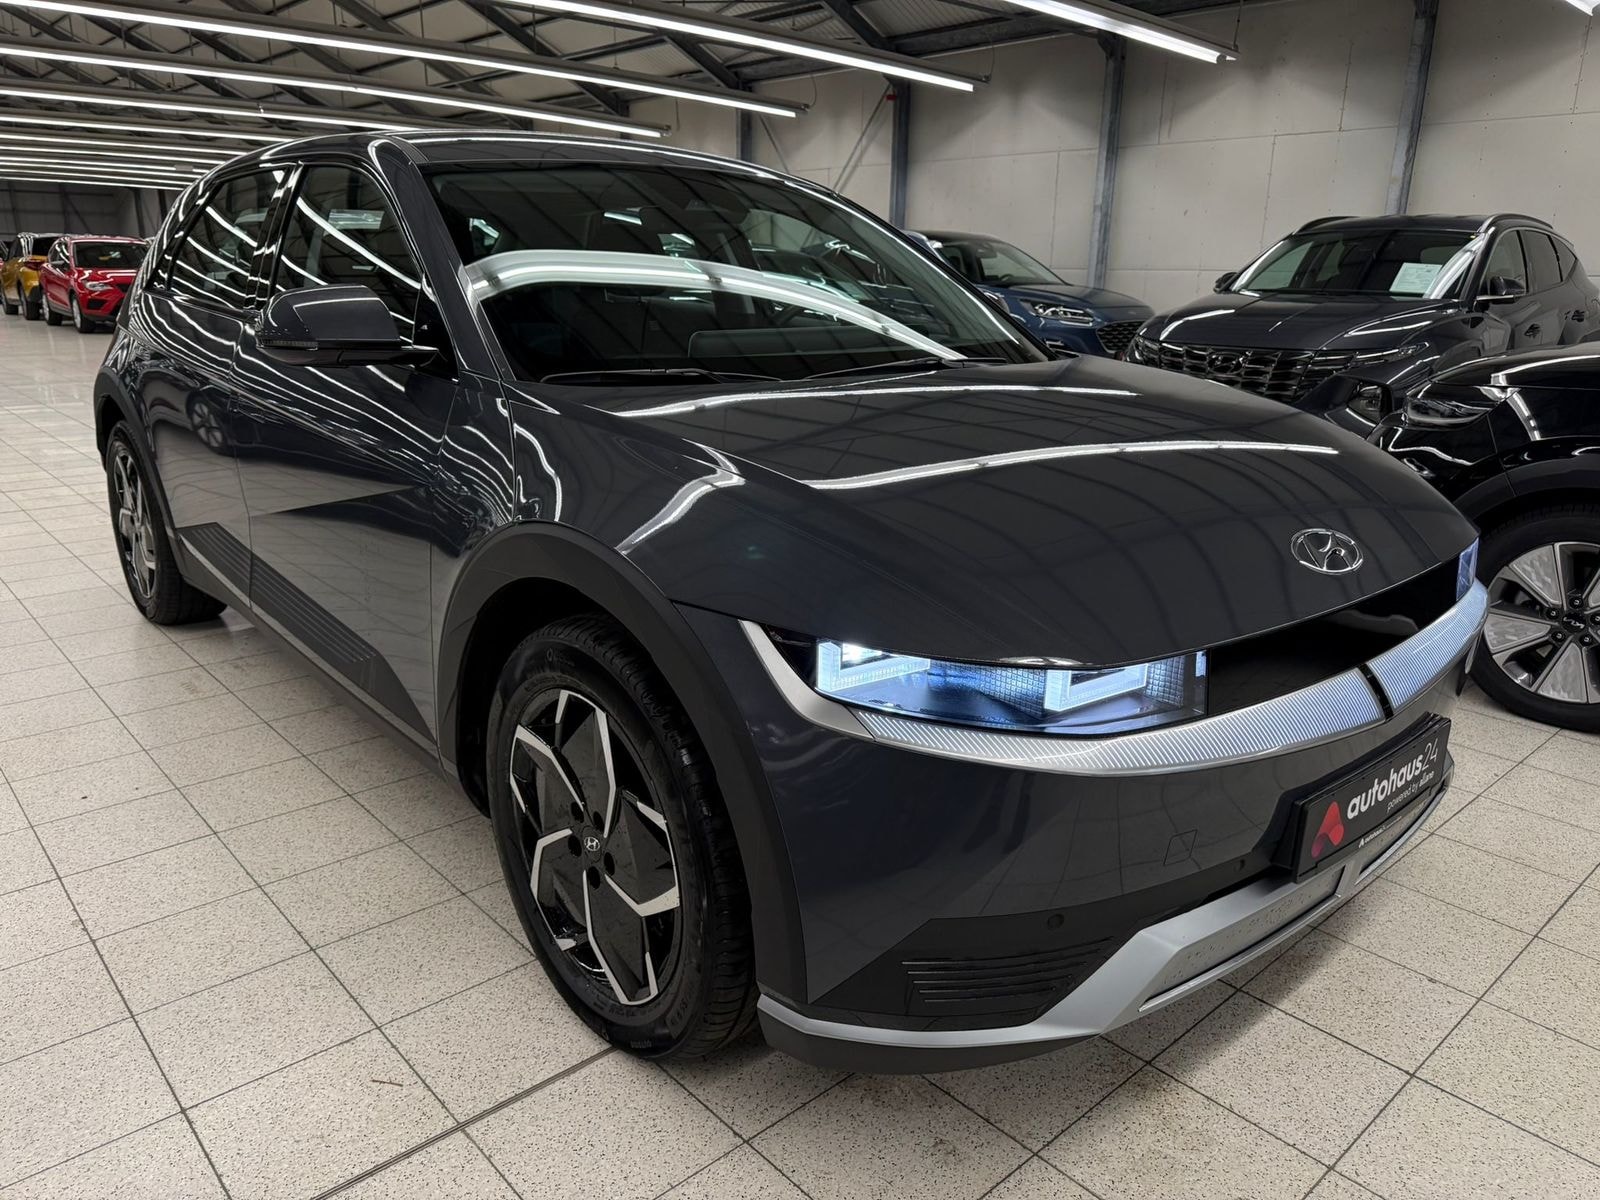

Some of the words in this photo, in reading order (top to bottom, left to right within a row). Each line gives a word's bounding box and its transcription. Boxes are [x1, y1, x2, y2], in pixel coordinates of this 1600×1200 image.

[1347, 738, 1438, 819] autohaus24
[1387, 783, 1412, 813] powered
[1412, 780, 1420, 793] by
